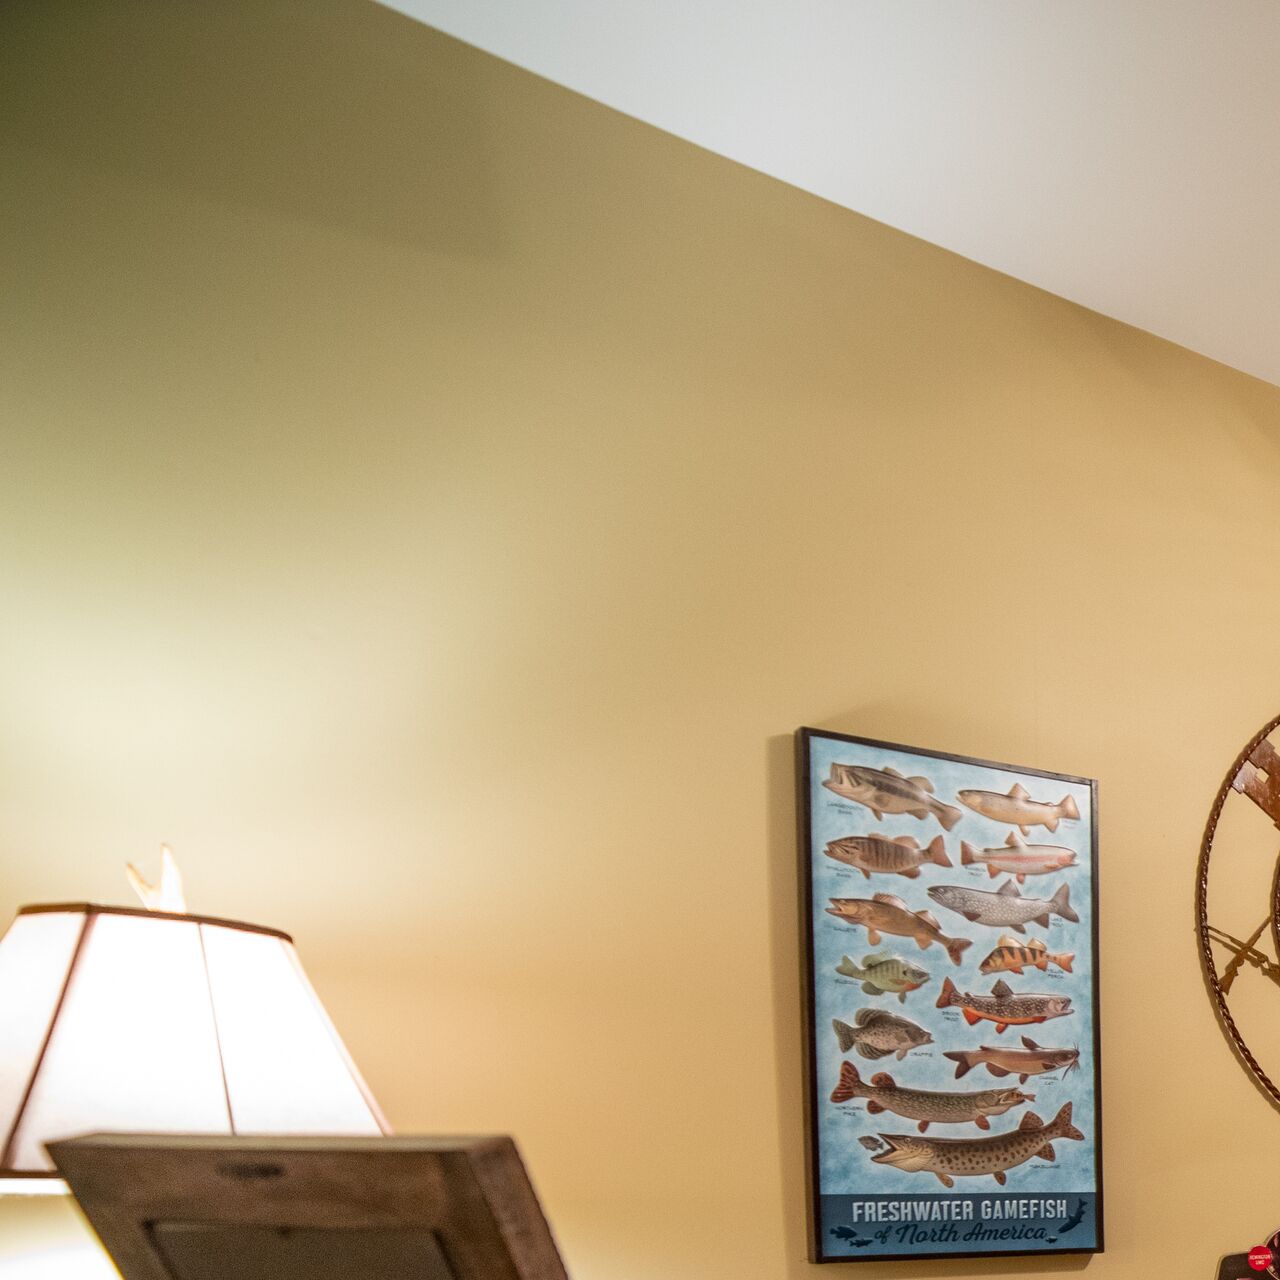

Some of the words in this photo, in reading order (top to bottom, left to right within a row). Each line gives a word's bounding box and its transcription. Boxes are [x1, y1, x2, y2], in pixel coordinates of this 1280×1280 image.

[852, 1200, 974, 1222] FRESHWATER
[981, 1199, 1067, 1220] GAMEFISH
[873, 1225, 894, 1244] of
[895, 1221, 960, 1243] North
[963, 1222, 1047, 1242] America
